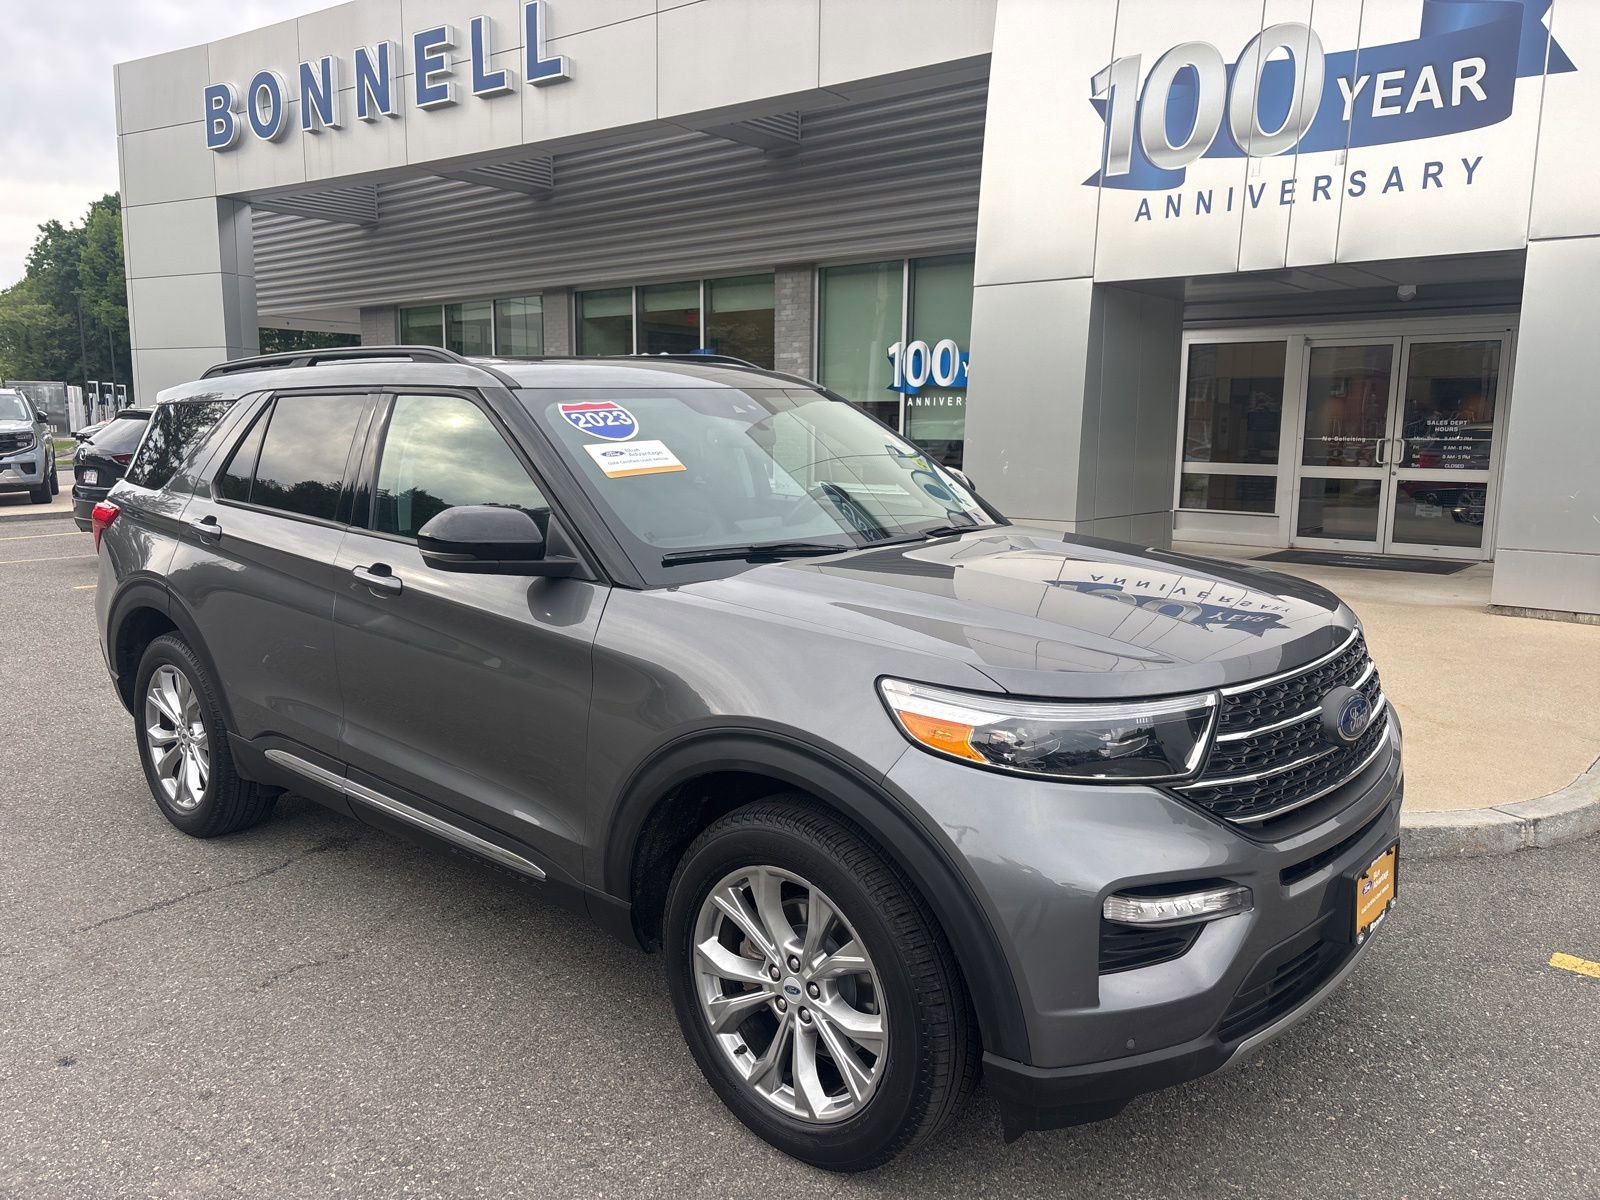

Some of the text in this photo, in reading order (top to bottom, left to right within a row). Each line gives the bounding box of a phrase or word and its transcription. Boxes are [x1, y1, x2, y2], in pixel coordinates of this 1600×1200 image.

[204, 1, 571, 151] BONNELL
[1090, 22, 1488, 177] 100 YEAR
[1134, 156, 1484, 222] ANNIVERSARY
[888, 339, 960, 387] 100
[571, 410, 633, 428] 2023
[907, 397, 967, 406] ANNIVER
[1334, 435, 1366, 443] Soliciting
